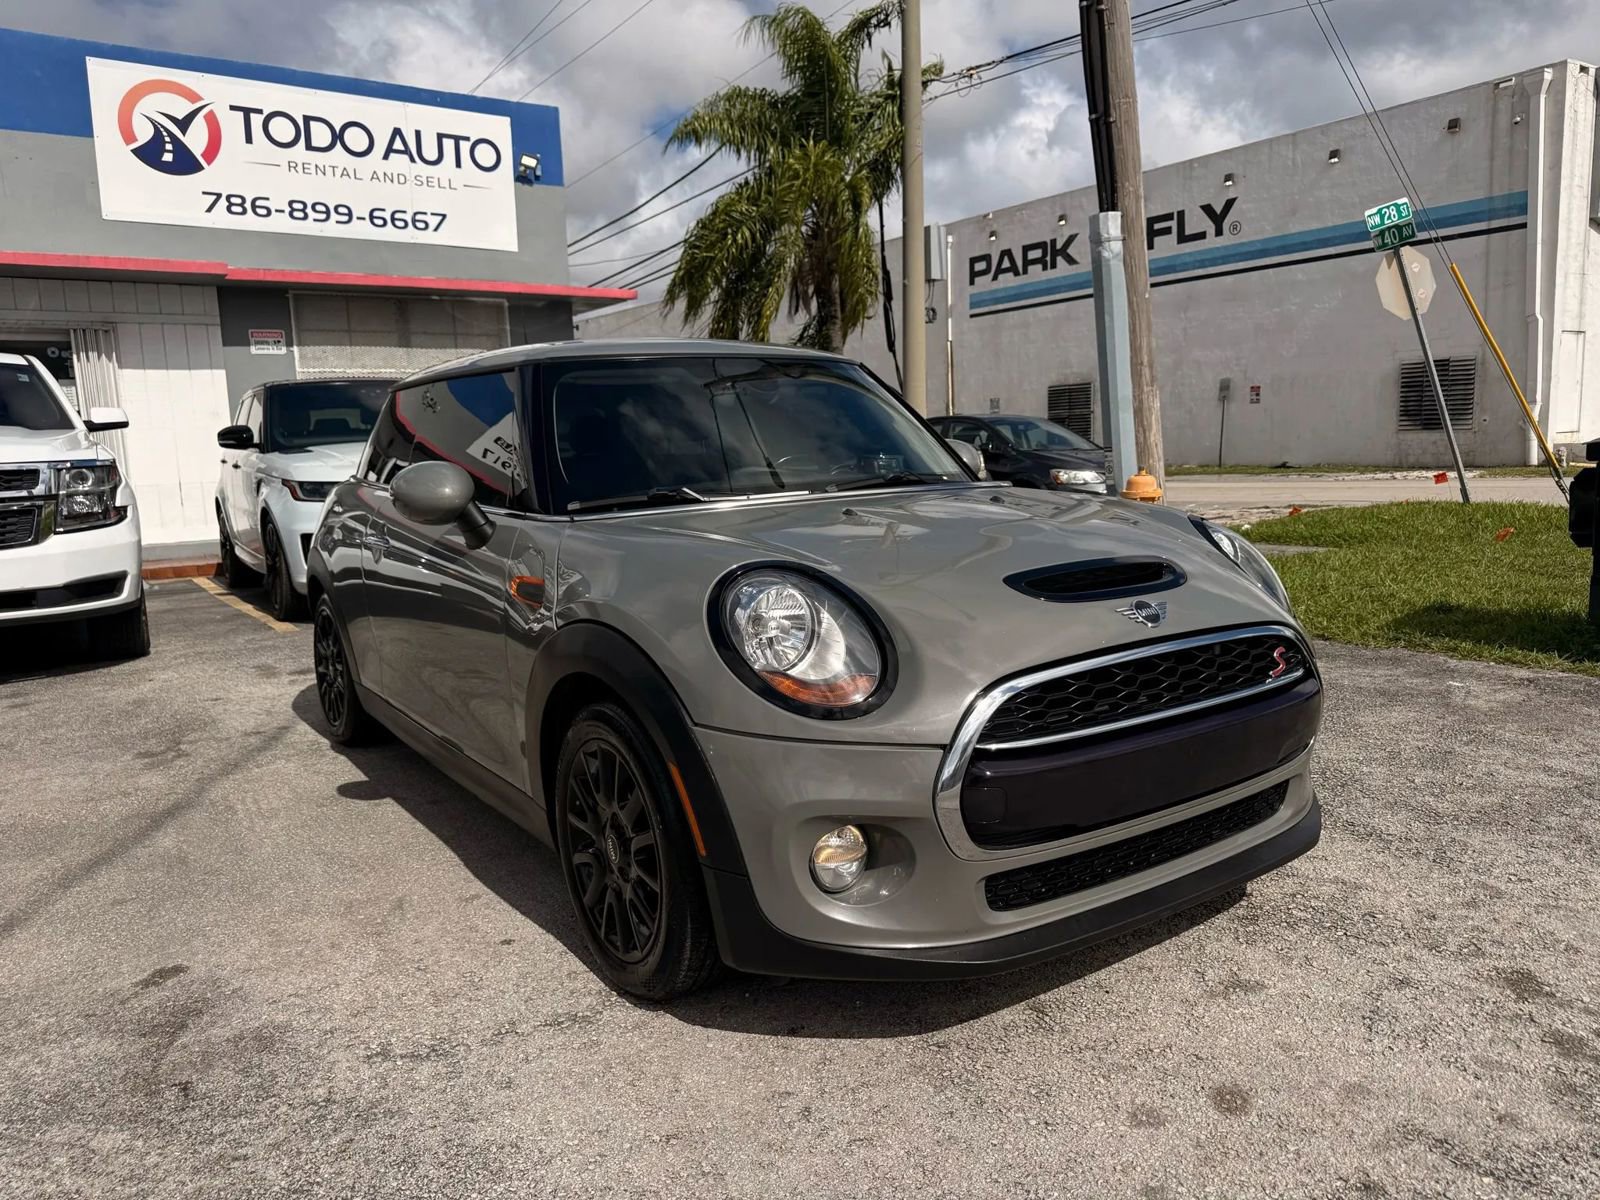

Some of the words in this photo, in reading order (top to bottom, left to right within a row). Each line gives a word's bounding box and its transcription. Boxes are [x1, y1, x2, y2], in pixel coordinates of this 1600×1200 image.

[229, 105, 375, 158] TODO
[382, 127, 501, 173] AUTO
[287, 160, 363, 181] RENTAL
[369, 171, 407, 185] AND
[414, 175, 458, 190] SELL
[201, 191, 447, 232] 786-899-6667
[1368, 214, 1380, 227] NW
[1382, 206, 1398, 224] 28
[1400, 205, 1408, 216] ST
[1384, 228, 1399, 245] 40
[1403, 225, 1412, 238] AV
[969, 233, 1080, 286] PARK
[1137, 607, 1158, 617] MINI
[1269, 646, 1286, 678] S
